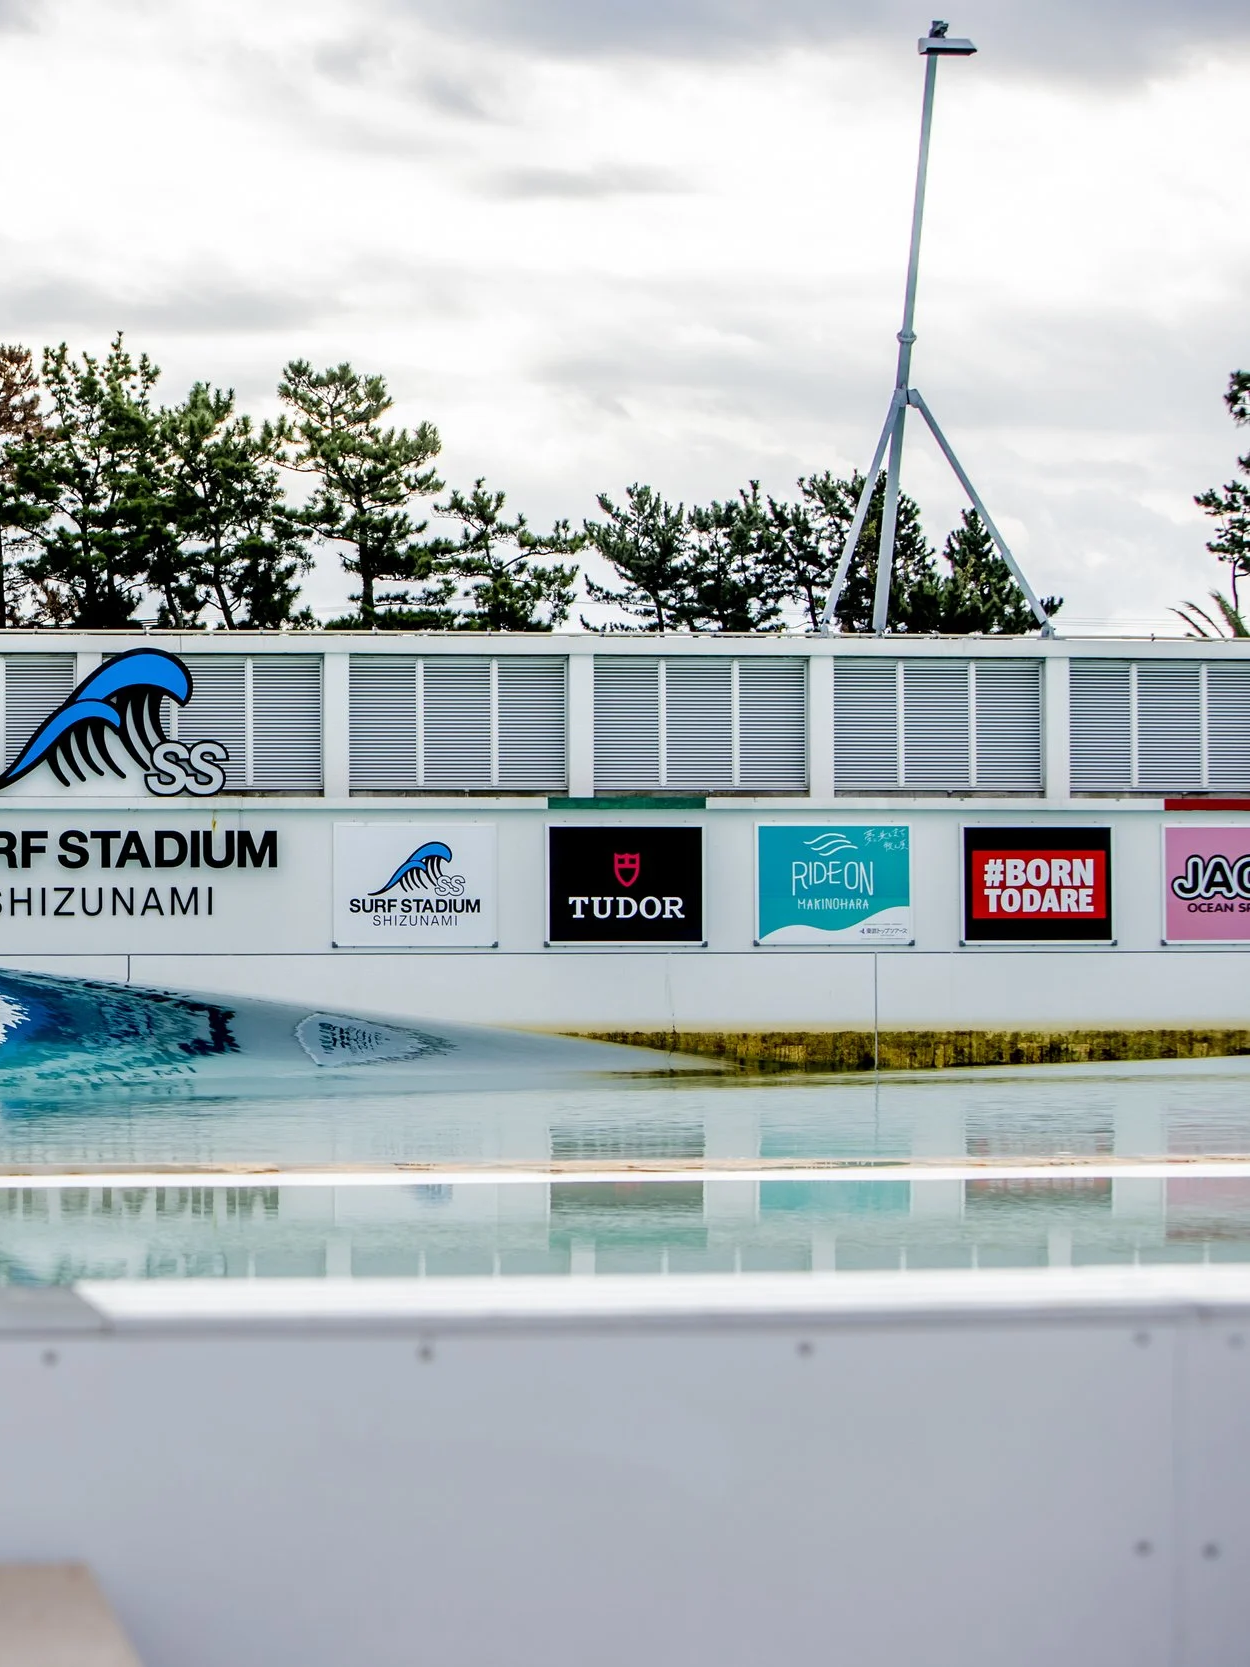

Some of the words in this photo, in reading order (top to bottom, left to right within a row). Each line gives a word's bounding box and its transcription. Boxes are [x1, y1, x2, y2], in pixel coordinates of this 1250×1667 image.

[57, 830, 278, 869] STADIUM
[983, 858, 1095, 887] #BORN
[349, 898, 398, 913] SURF
[400, 898, 481, 913] STADIUM
[568, 896, 686, 919] TUDOR
[797, 898, 869, 910] MAKINOHARA
[983, 888, 1095, 913] TODARE
[1187, 903, 1234, 913] OCEAN
[372, 914, 458, 926] SHIZUNAMI
